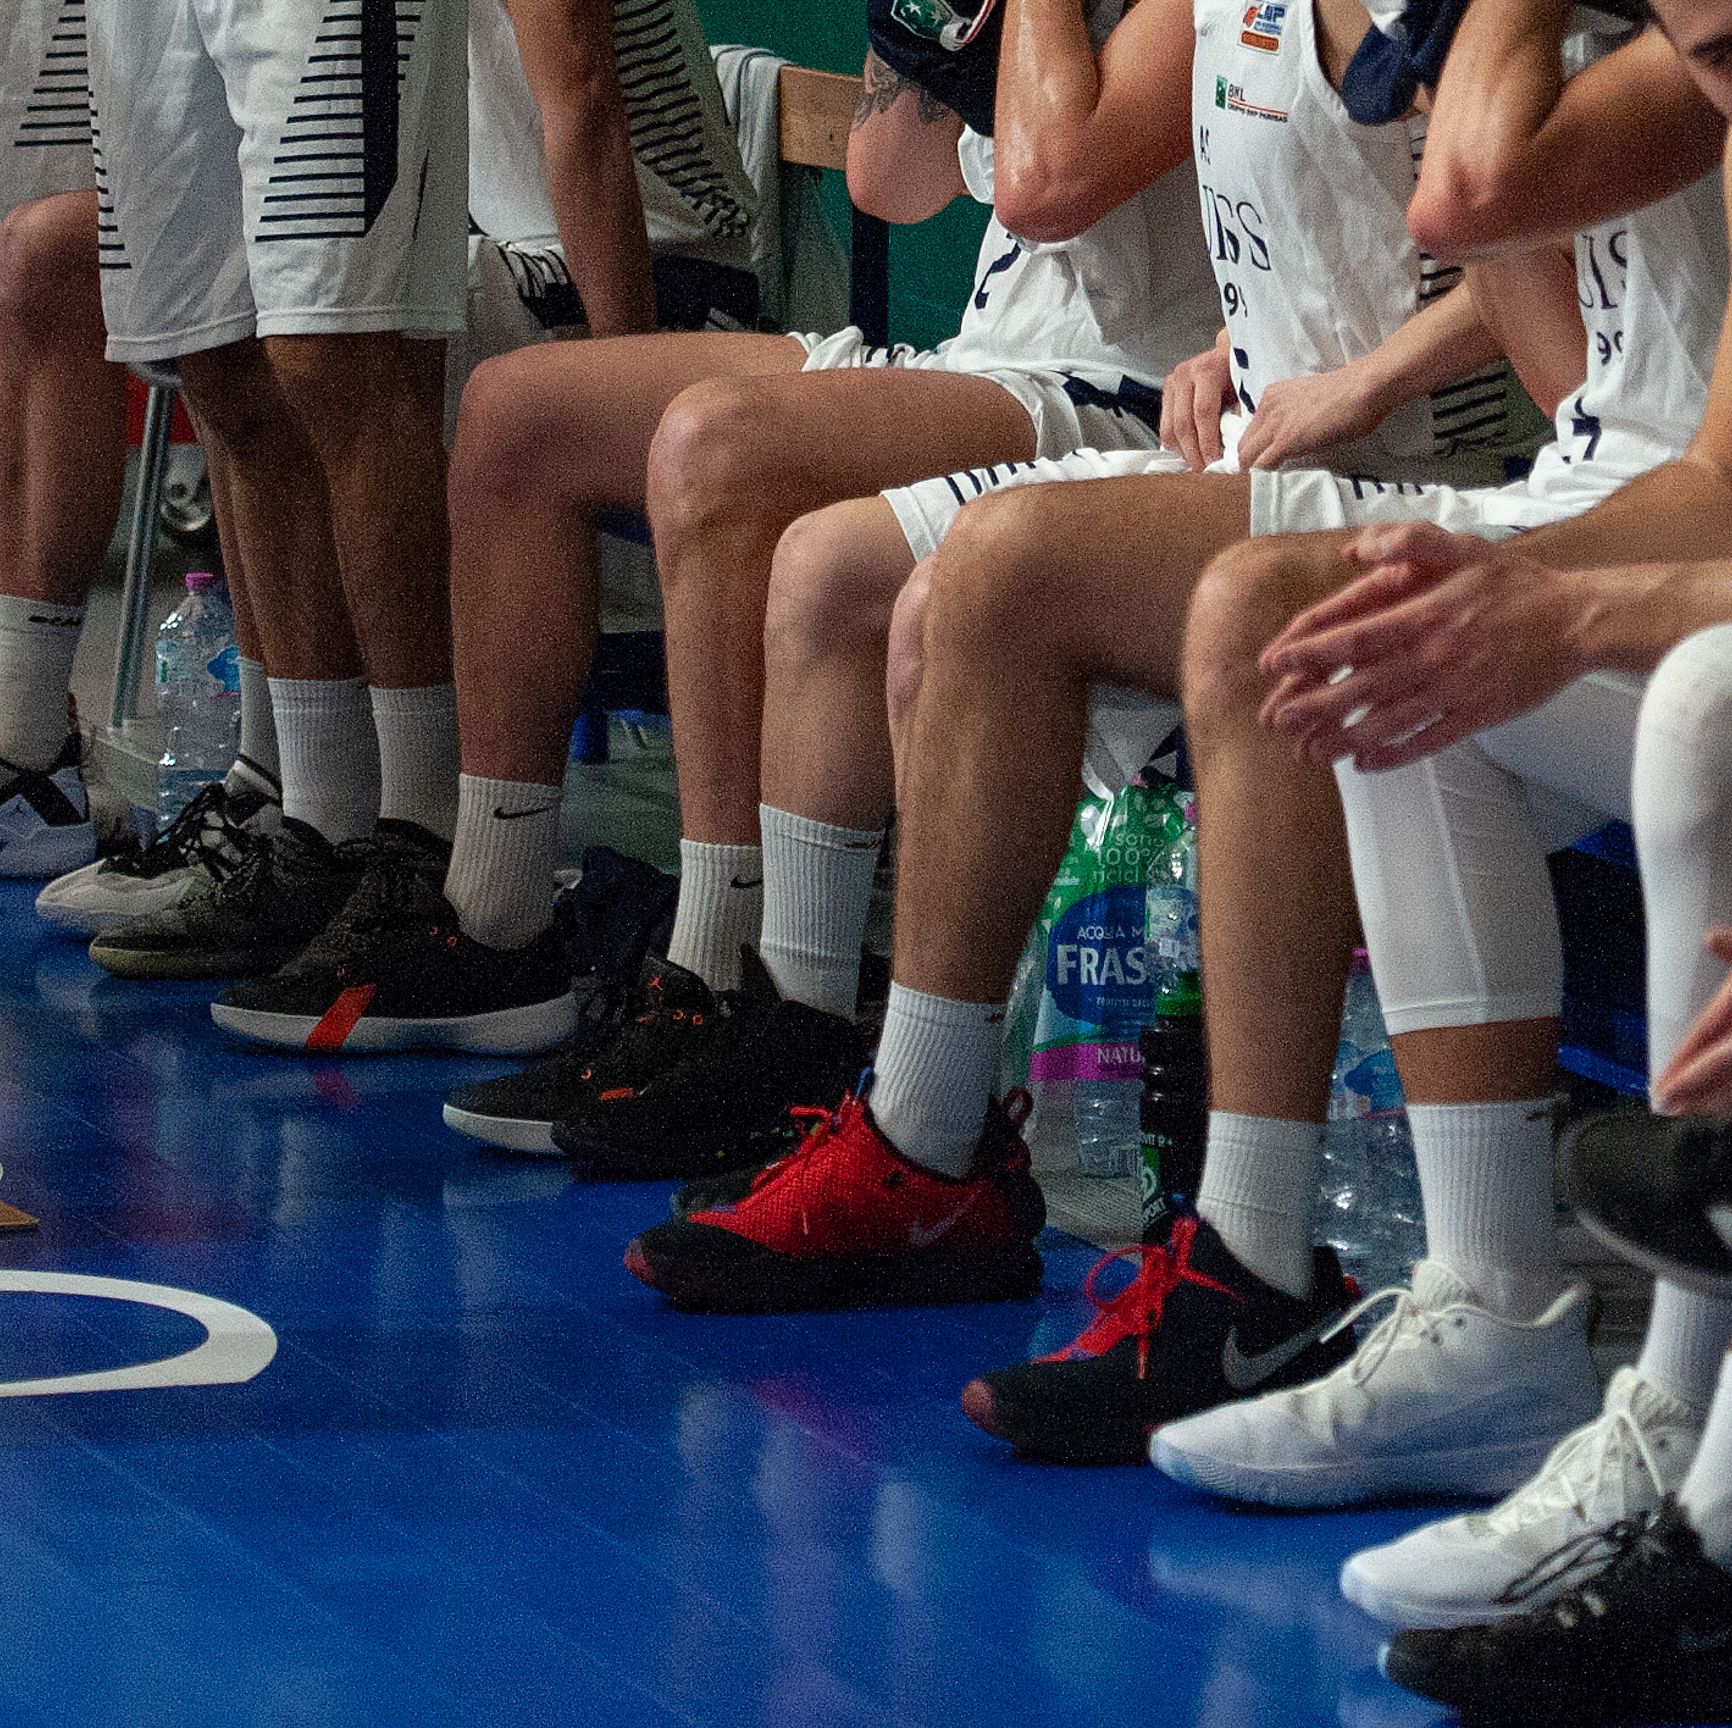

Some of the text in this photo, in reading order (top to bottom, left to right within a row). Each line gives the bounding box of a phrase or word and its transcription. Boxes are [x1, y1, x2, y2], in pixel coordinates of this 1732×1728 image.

[1076, 925, 1126, 941] ACQUA
[1056, 943, 1148, 986] FRAS
[1097, 1046, 1147, 1064] NATU
